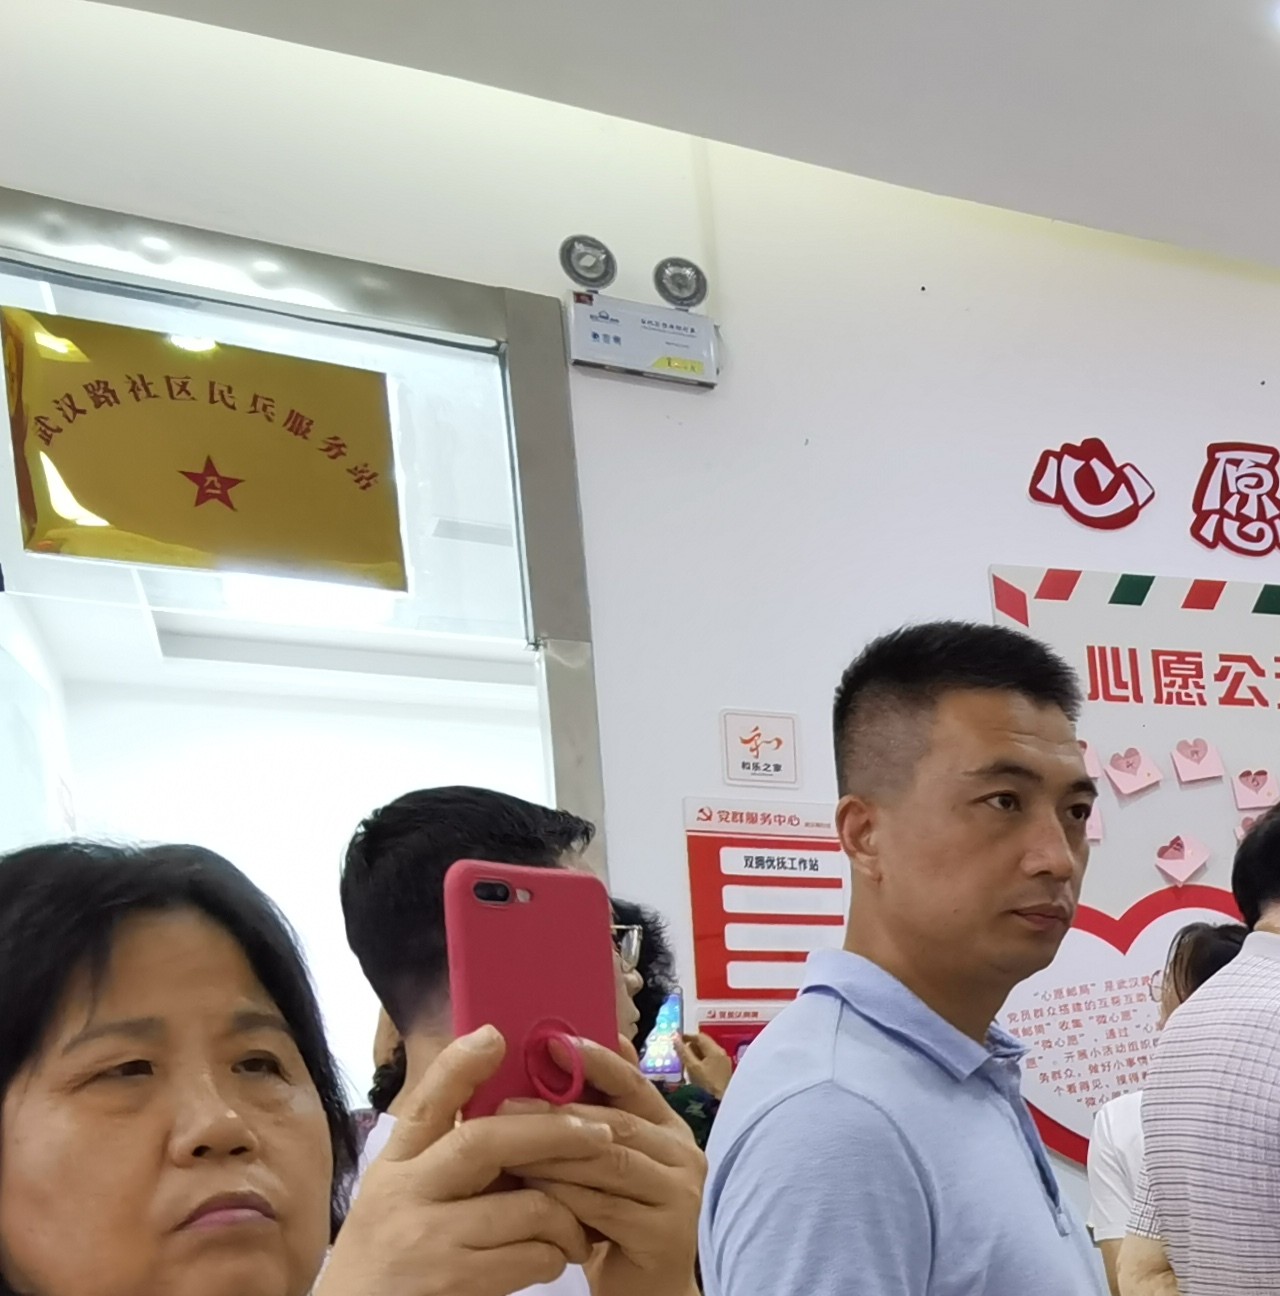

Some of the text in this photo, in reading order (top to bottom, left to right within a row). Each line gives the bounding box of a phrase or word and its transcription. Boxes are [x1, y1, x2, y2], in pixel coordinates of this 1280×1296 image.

[32, 373, 380, 491] 武汉路社区民兵服务站
[741, 761, 782, 773] 和乐之家
[717, 810, 800, 827] 党群服务中心
[743, 855, 819, 872] 双拥优抚工作站
